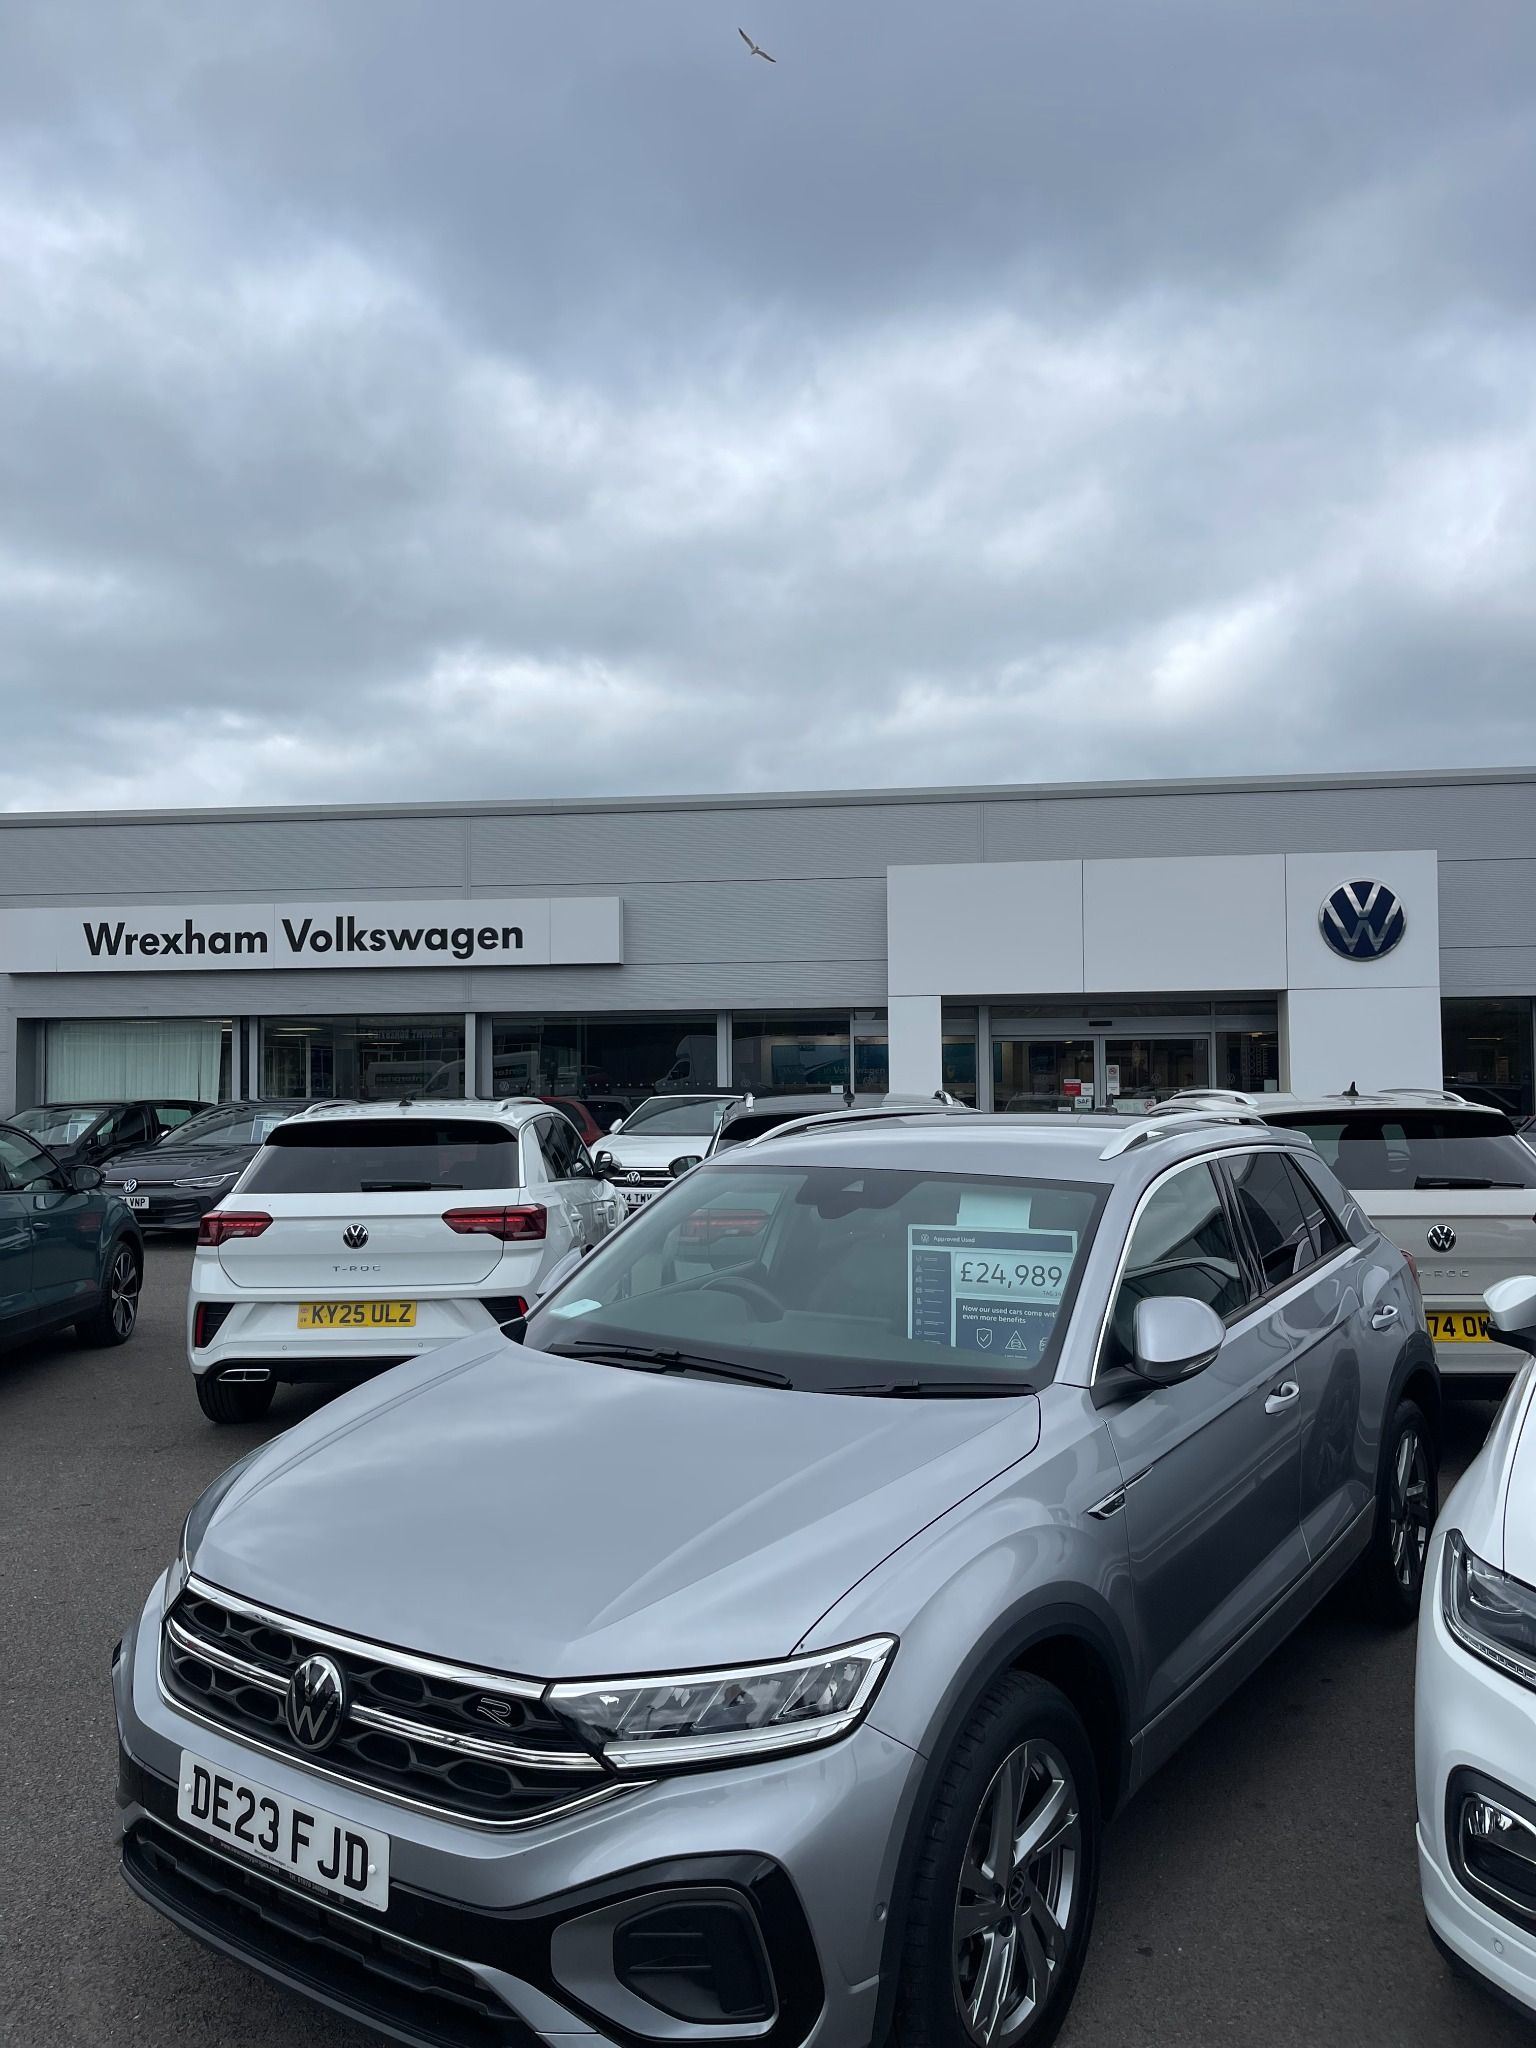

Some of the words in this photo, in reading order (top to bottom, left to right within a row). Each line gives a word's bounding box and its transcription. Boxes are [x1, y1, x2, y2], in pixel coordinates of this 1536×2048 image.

[83, 919, 268, 956] Wrexham
[281, 916, 523, 960] Volkswagen
[129, 1197, 146, 1207] VNP
[933, 1234, 960, 1243] Approved
[960, 1235, 976, 1243] Used
[331, 1264, 382, 1272] T-ROC
[960, 1261, 1062, 1288] £24,989
[311, 1304, 365, 1324] KY25
[371, 1303, 412, 1323] ULZ
[962, 1304, 978, 1312] Now
[991, 1307, 1008, 1315] used
[1008, 1308, 1023, 1316] cars
[1043, 1310, 1058, 1318] wit
[998, 1315, 1027, 1324] benefits
[1462, 1315, 1491, 1337] OW
[190, 1763, 280, 1853] DE23
